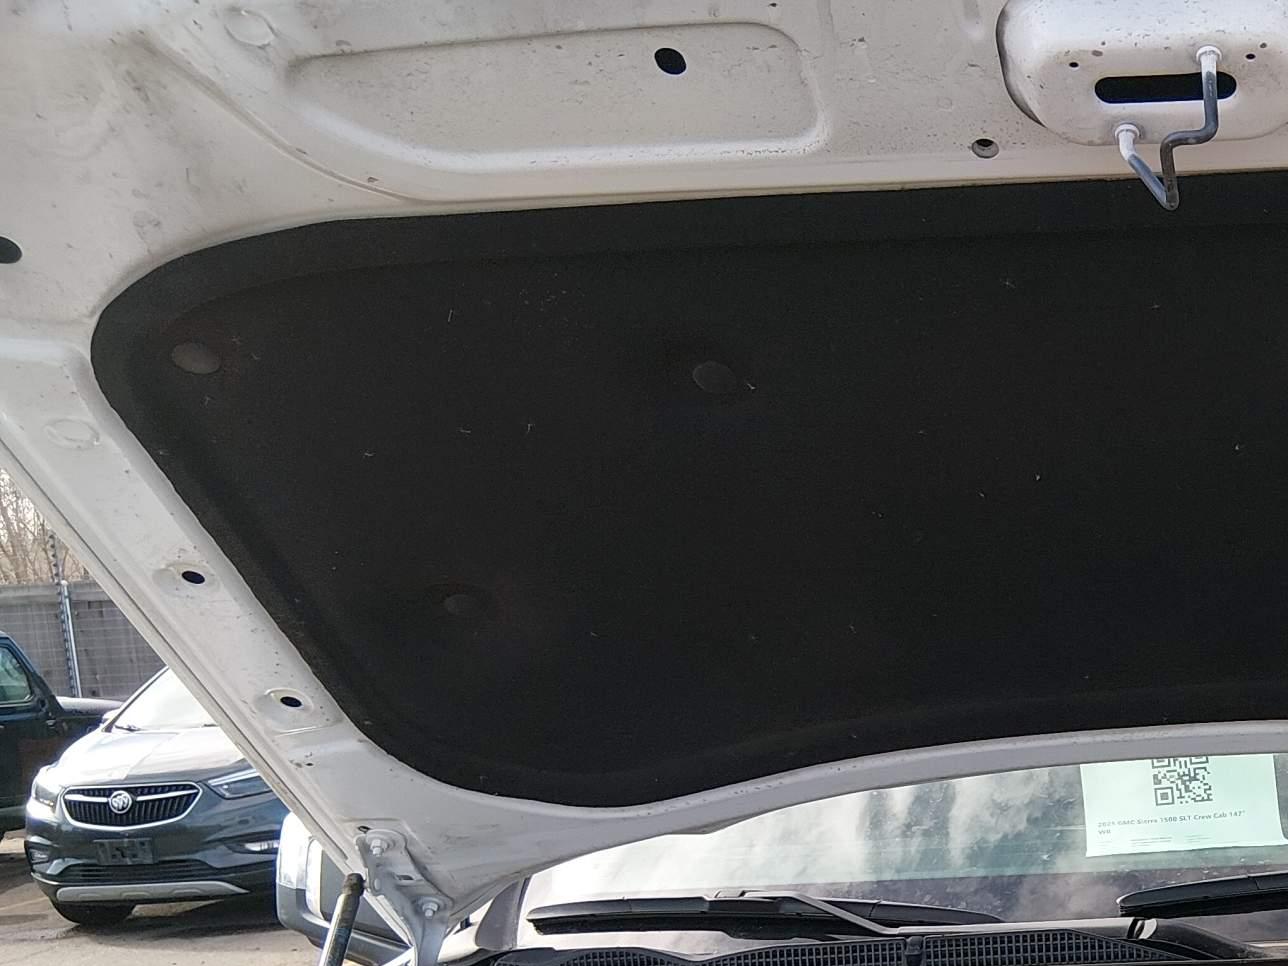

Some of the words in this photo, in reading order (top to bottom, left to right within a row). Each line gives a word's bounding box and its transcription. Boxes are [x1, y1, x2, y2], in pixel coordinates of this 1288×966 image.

[1160, 815, 1177, 823] 1500
[1194, 813, 1212, 821] Crew
[1213, 811, 1227, 819] Cab
